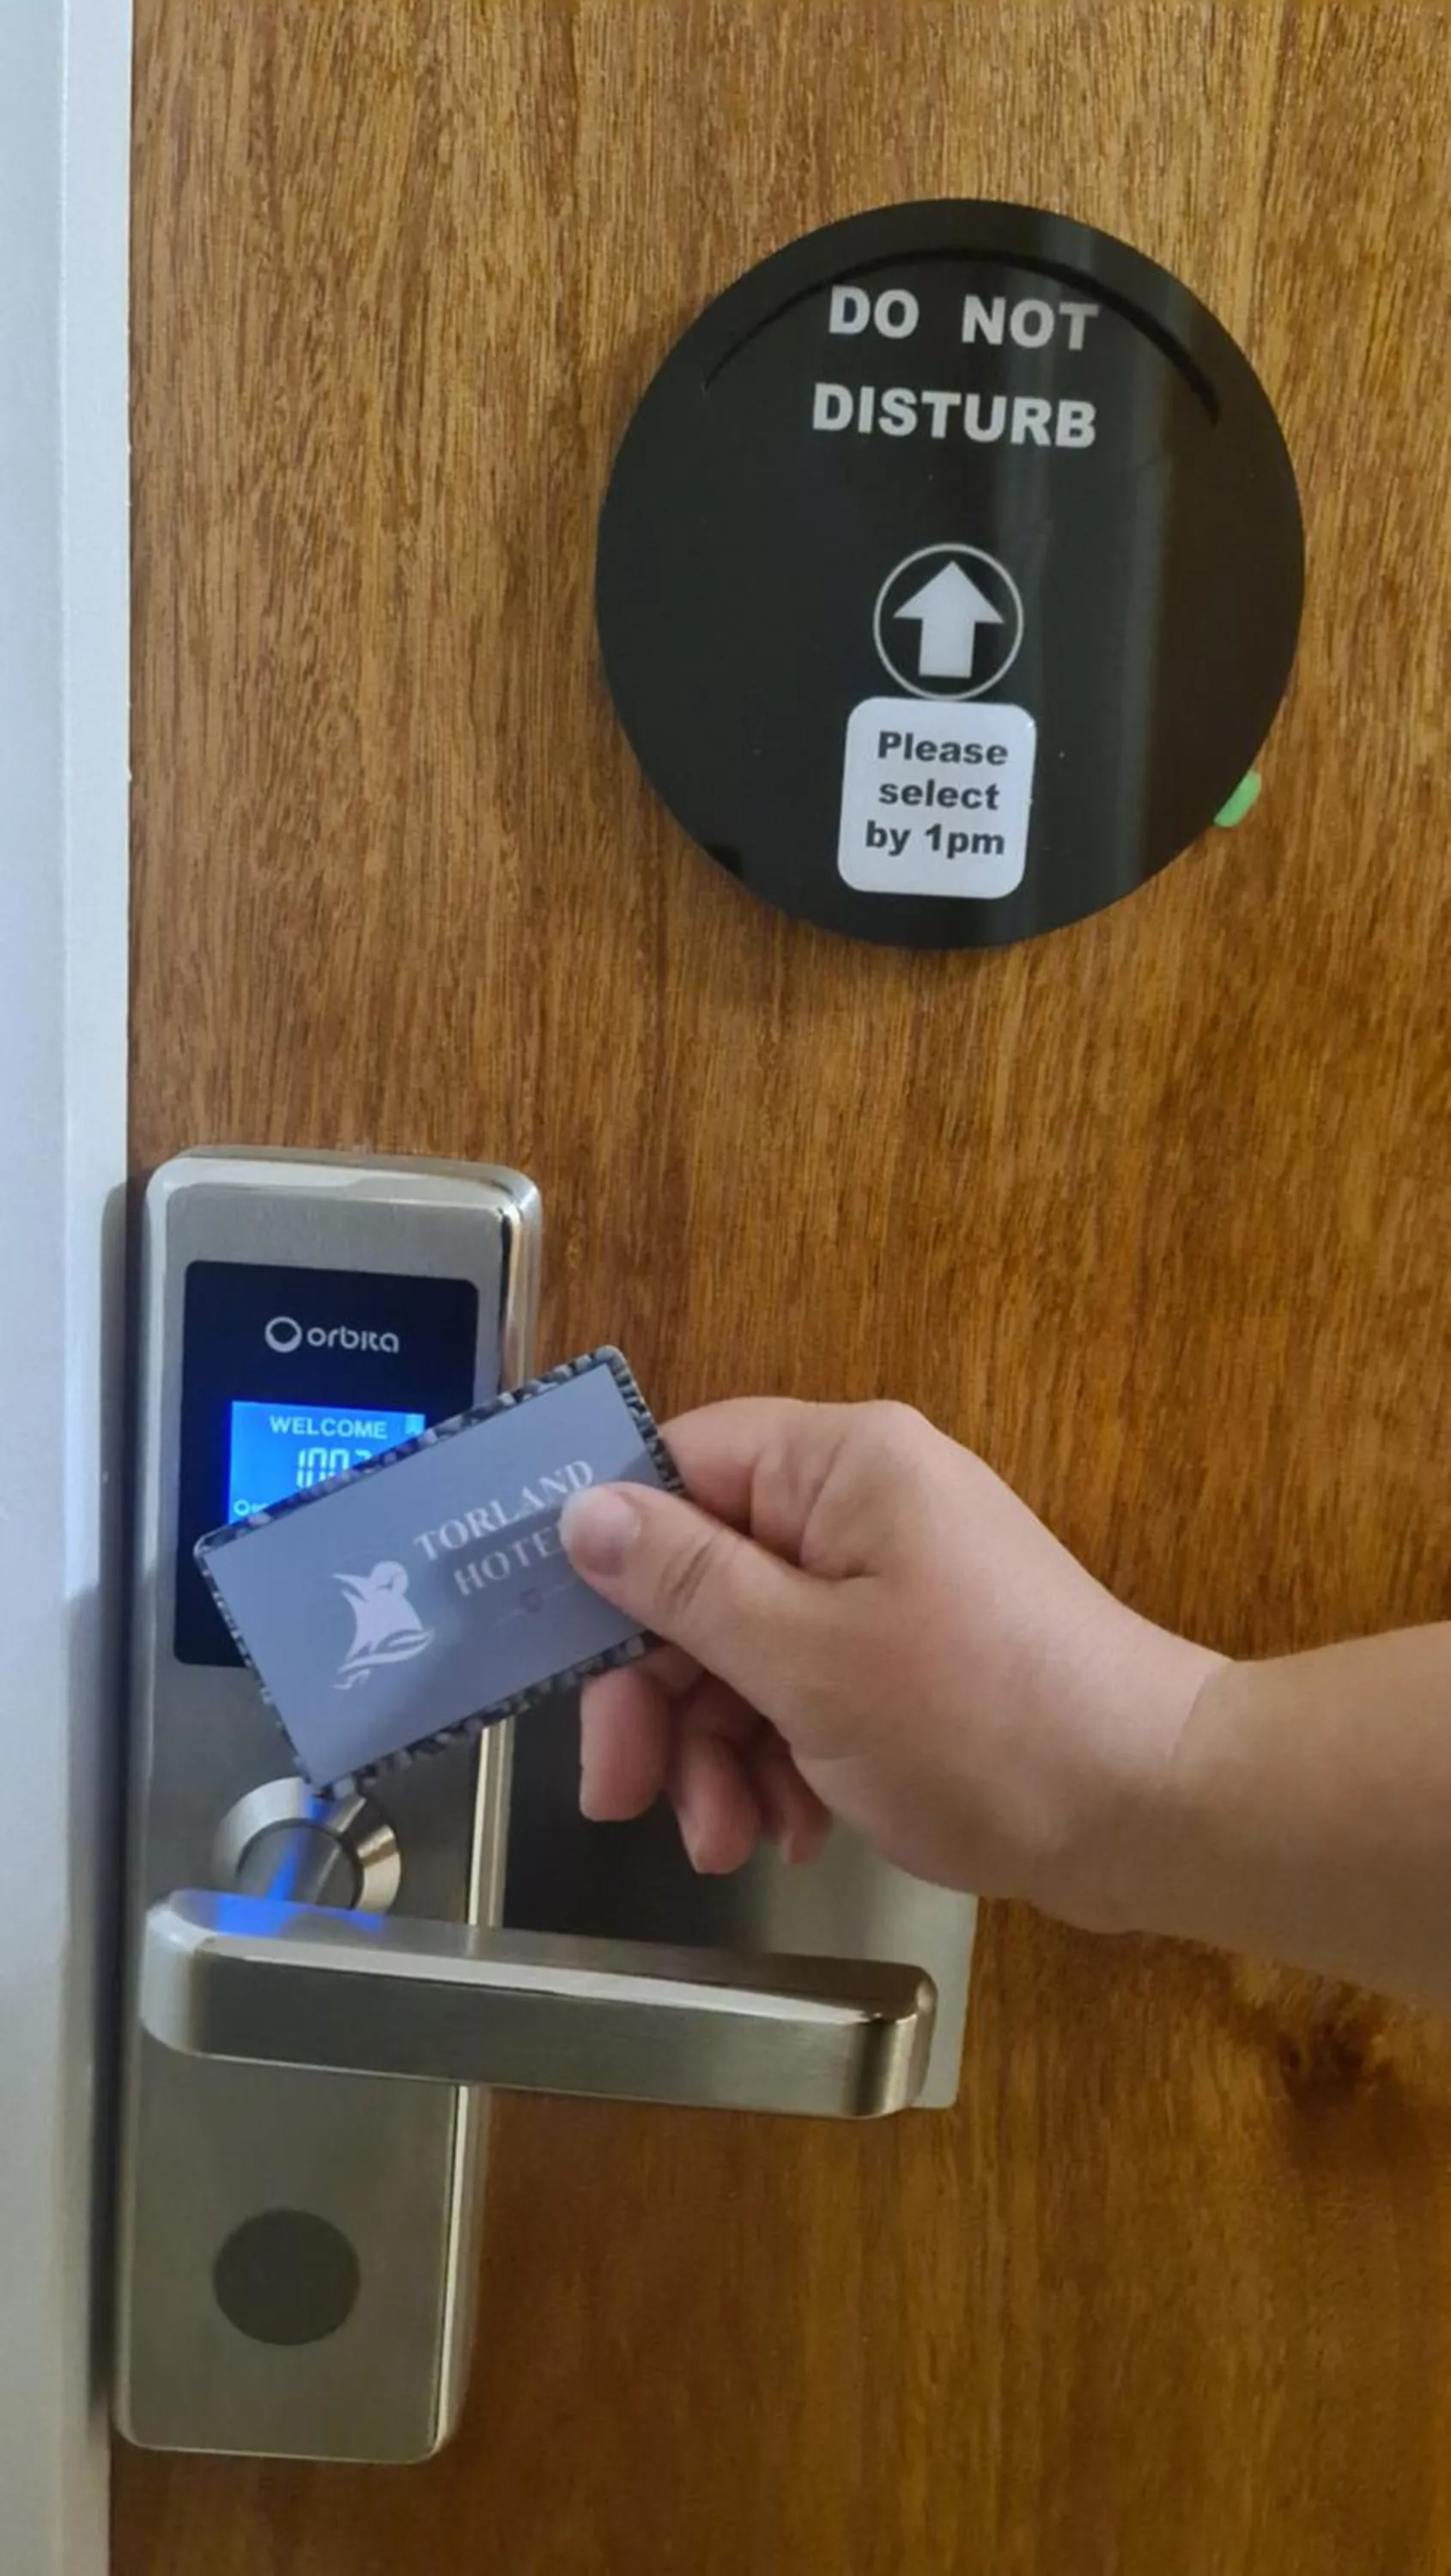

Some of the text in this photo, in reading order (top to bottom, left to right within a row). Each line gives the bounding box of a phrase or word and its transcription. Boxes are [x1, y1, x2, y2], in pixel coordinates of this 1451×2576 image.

[829, 285, 1099, 351] DO NOT
[812, 382, 1096, 448] DISTURB
[877, 730, 1009, 766] Please
[878, 779, 1000, 811] select
[865, 819, 1005, 860] by 1pm
[307, 1326, 400, 1353] orbita
[269, 1414, 389, 1440] WELCOME
[413, 1460, 595, 1562] TORLAND
[452, 1524, 564, 1597] HOTE
